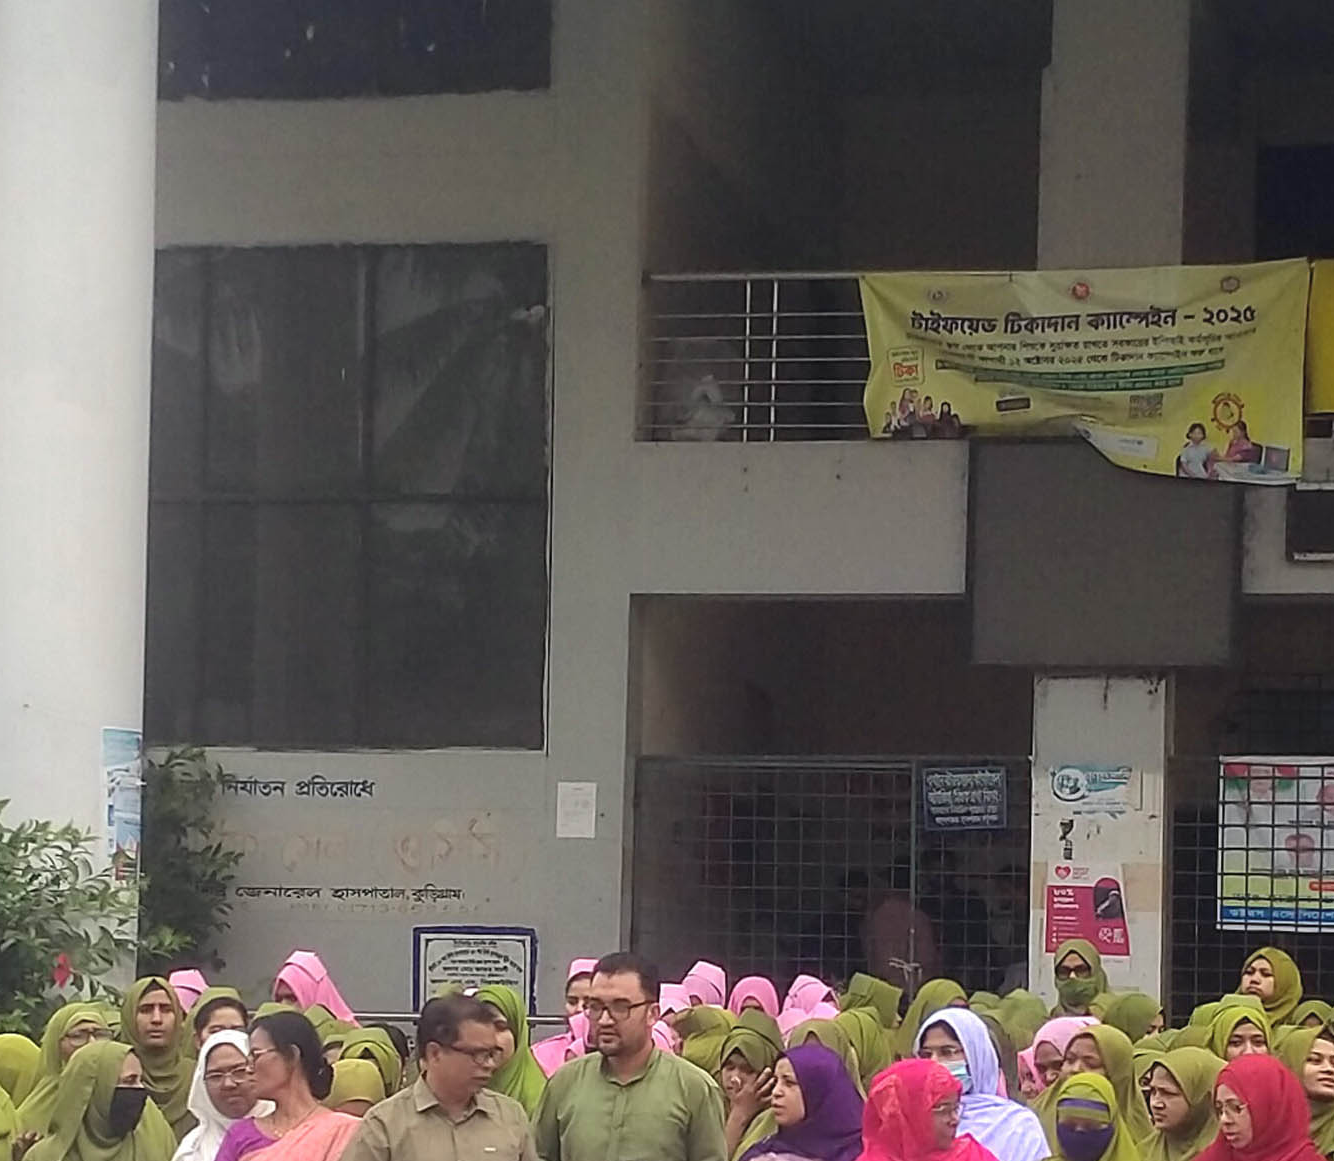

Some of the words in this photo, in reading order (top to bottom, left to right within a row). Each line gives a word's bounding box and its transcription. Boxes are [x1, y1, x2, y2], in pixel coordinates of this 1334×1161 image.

[910, 310, 999, 336] টাইফয়েড
[1003, 311, 1082, 335] টিকাদান
[1086, 305, 1178, 331] ক্যাম্পেইন
[1202, 305, 1257, 326] ২০২৫
[221, 774, 286, 798] নির্যাতন
[295, 775, 376, 799] প্রতিরোধে
[234, 885, 322, 899] জেনারেল
